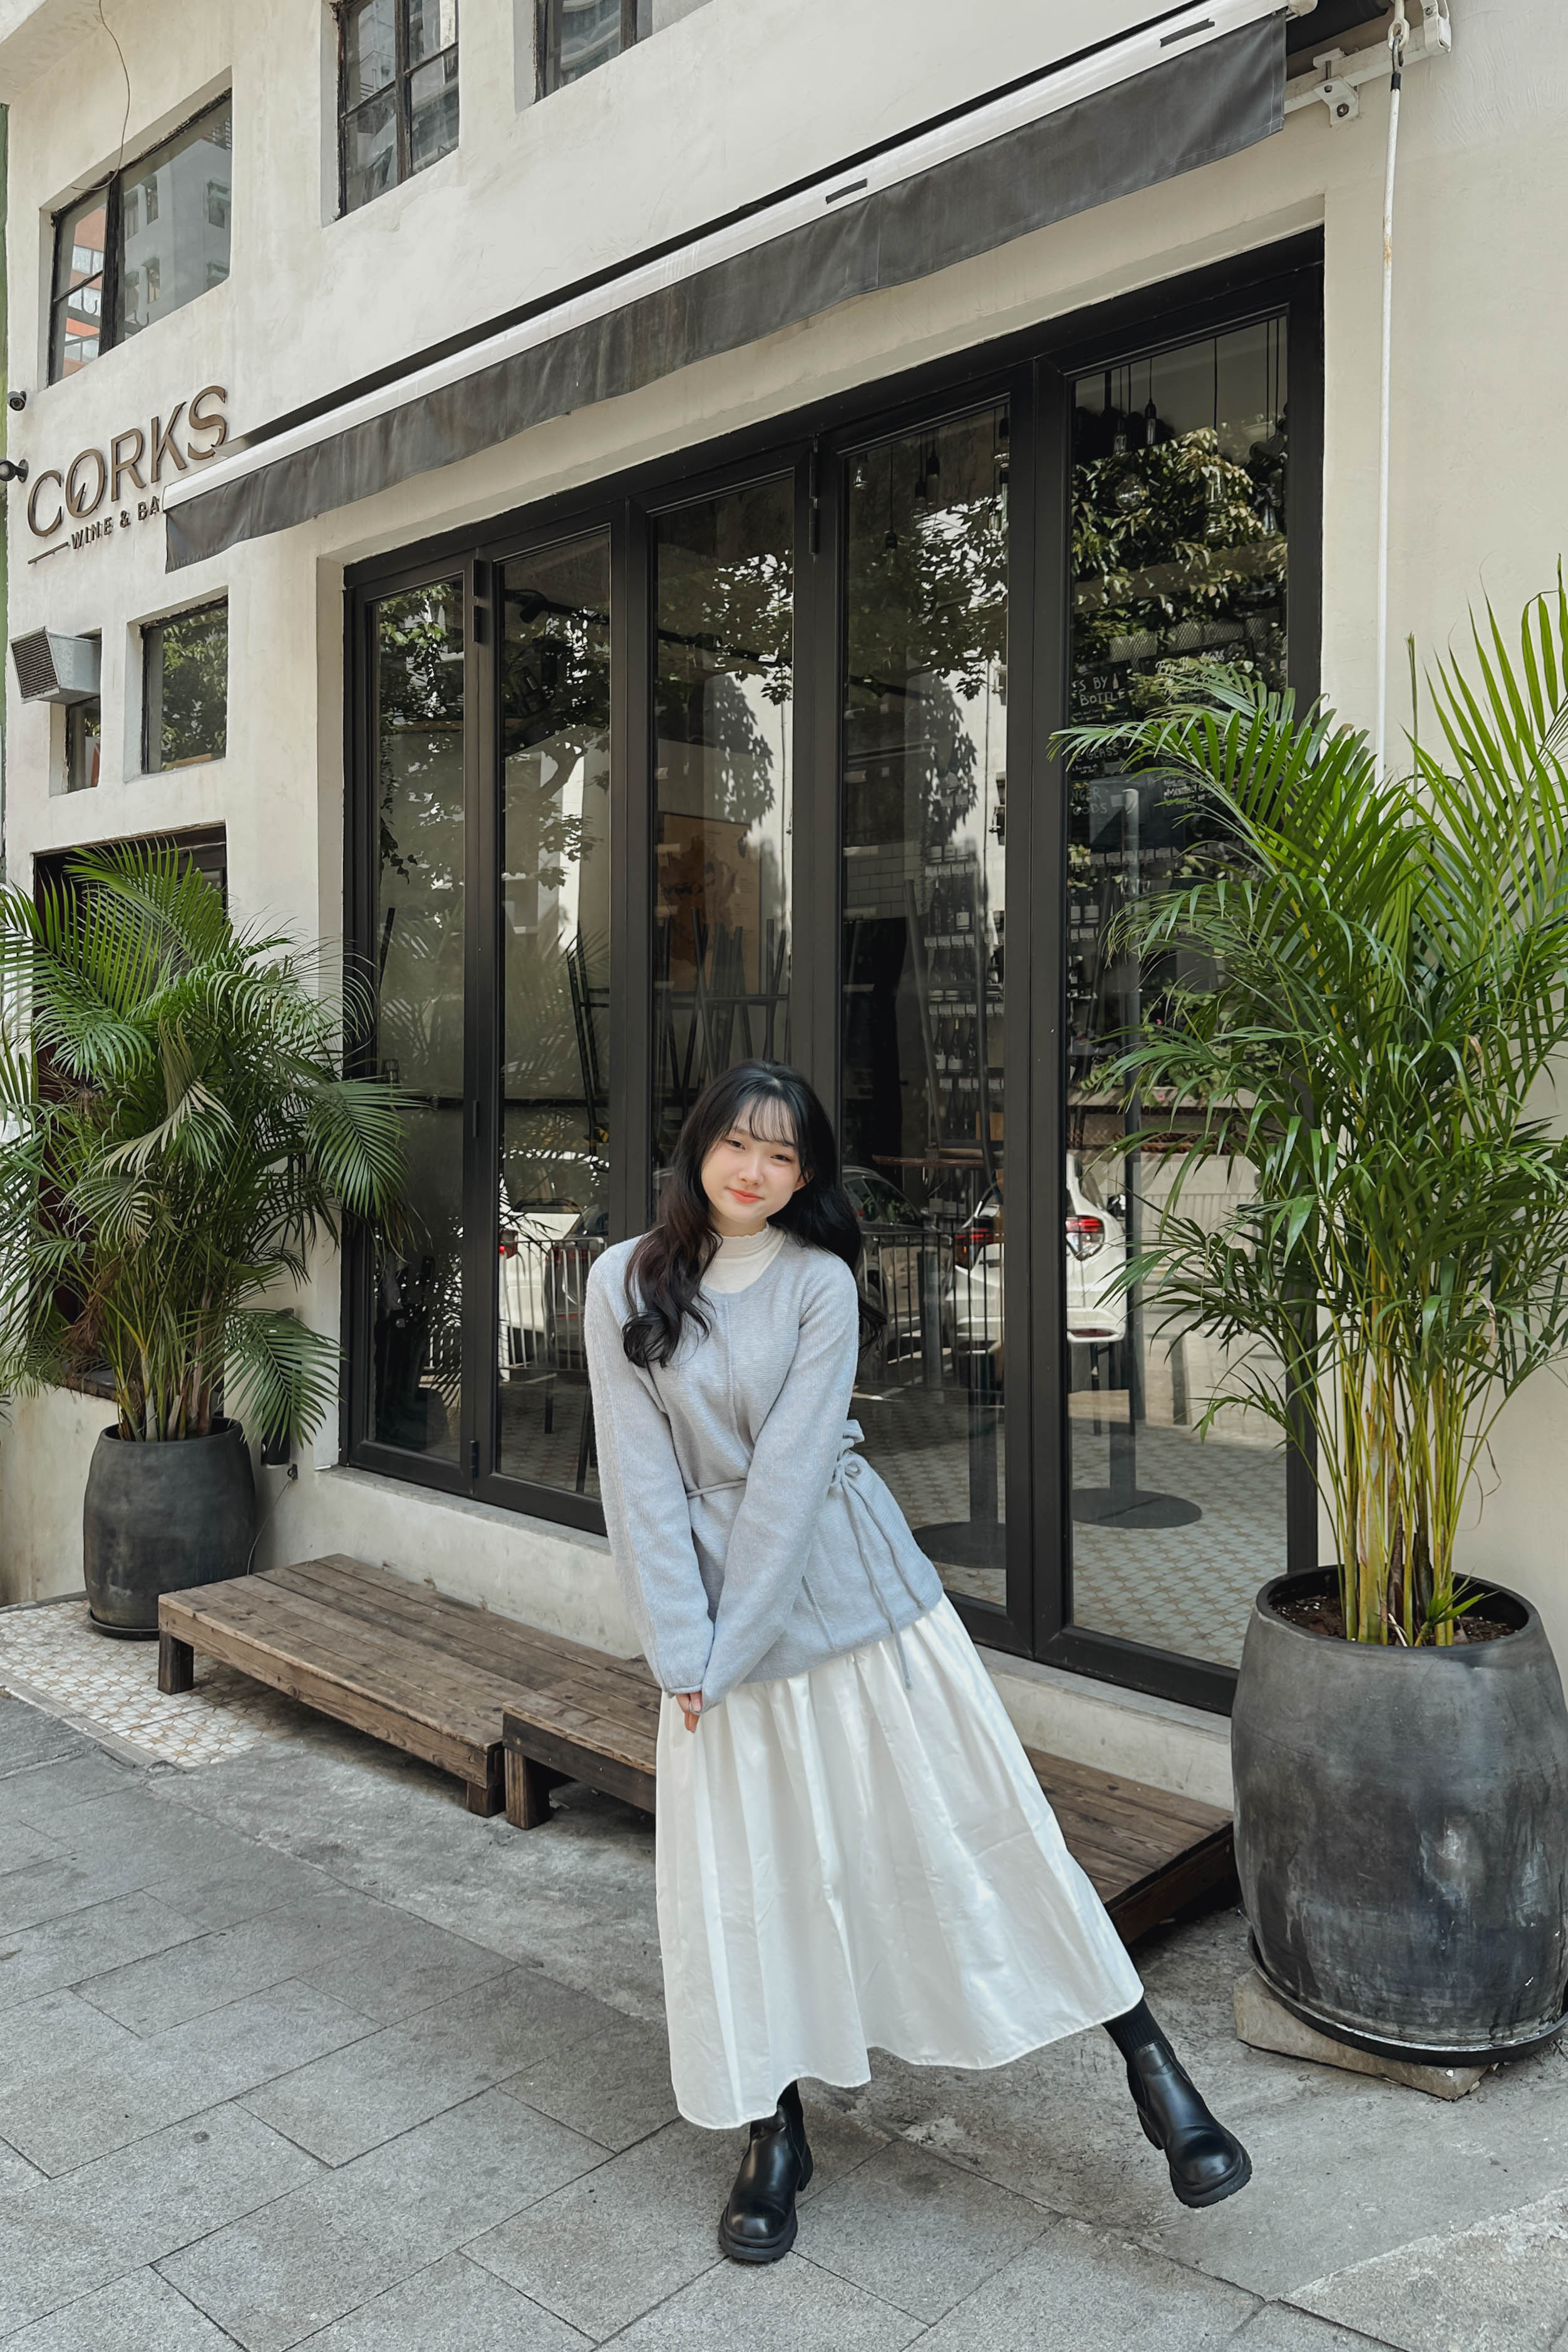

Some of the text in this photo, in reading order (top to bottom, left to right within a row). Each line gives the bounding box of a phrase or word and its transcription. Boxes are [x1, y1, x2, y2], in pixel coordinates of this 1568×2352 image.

[28, 385, 227, 537] CORKS
[71, 495, 160, 549] WINE & BA
[1093, 676, 1108, 690] BY
[1071, 787, 1101, 801] NGER
[1072, 803, 1108, 815] OODS
